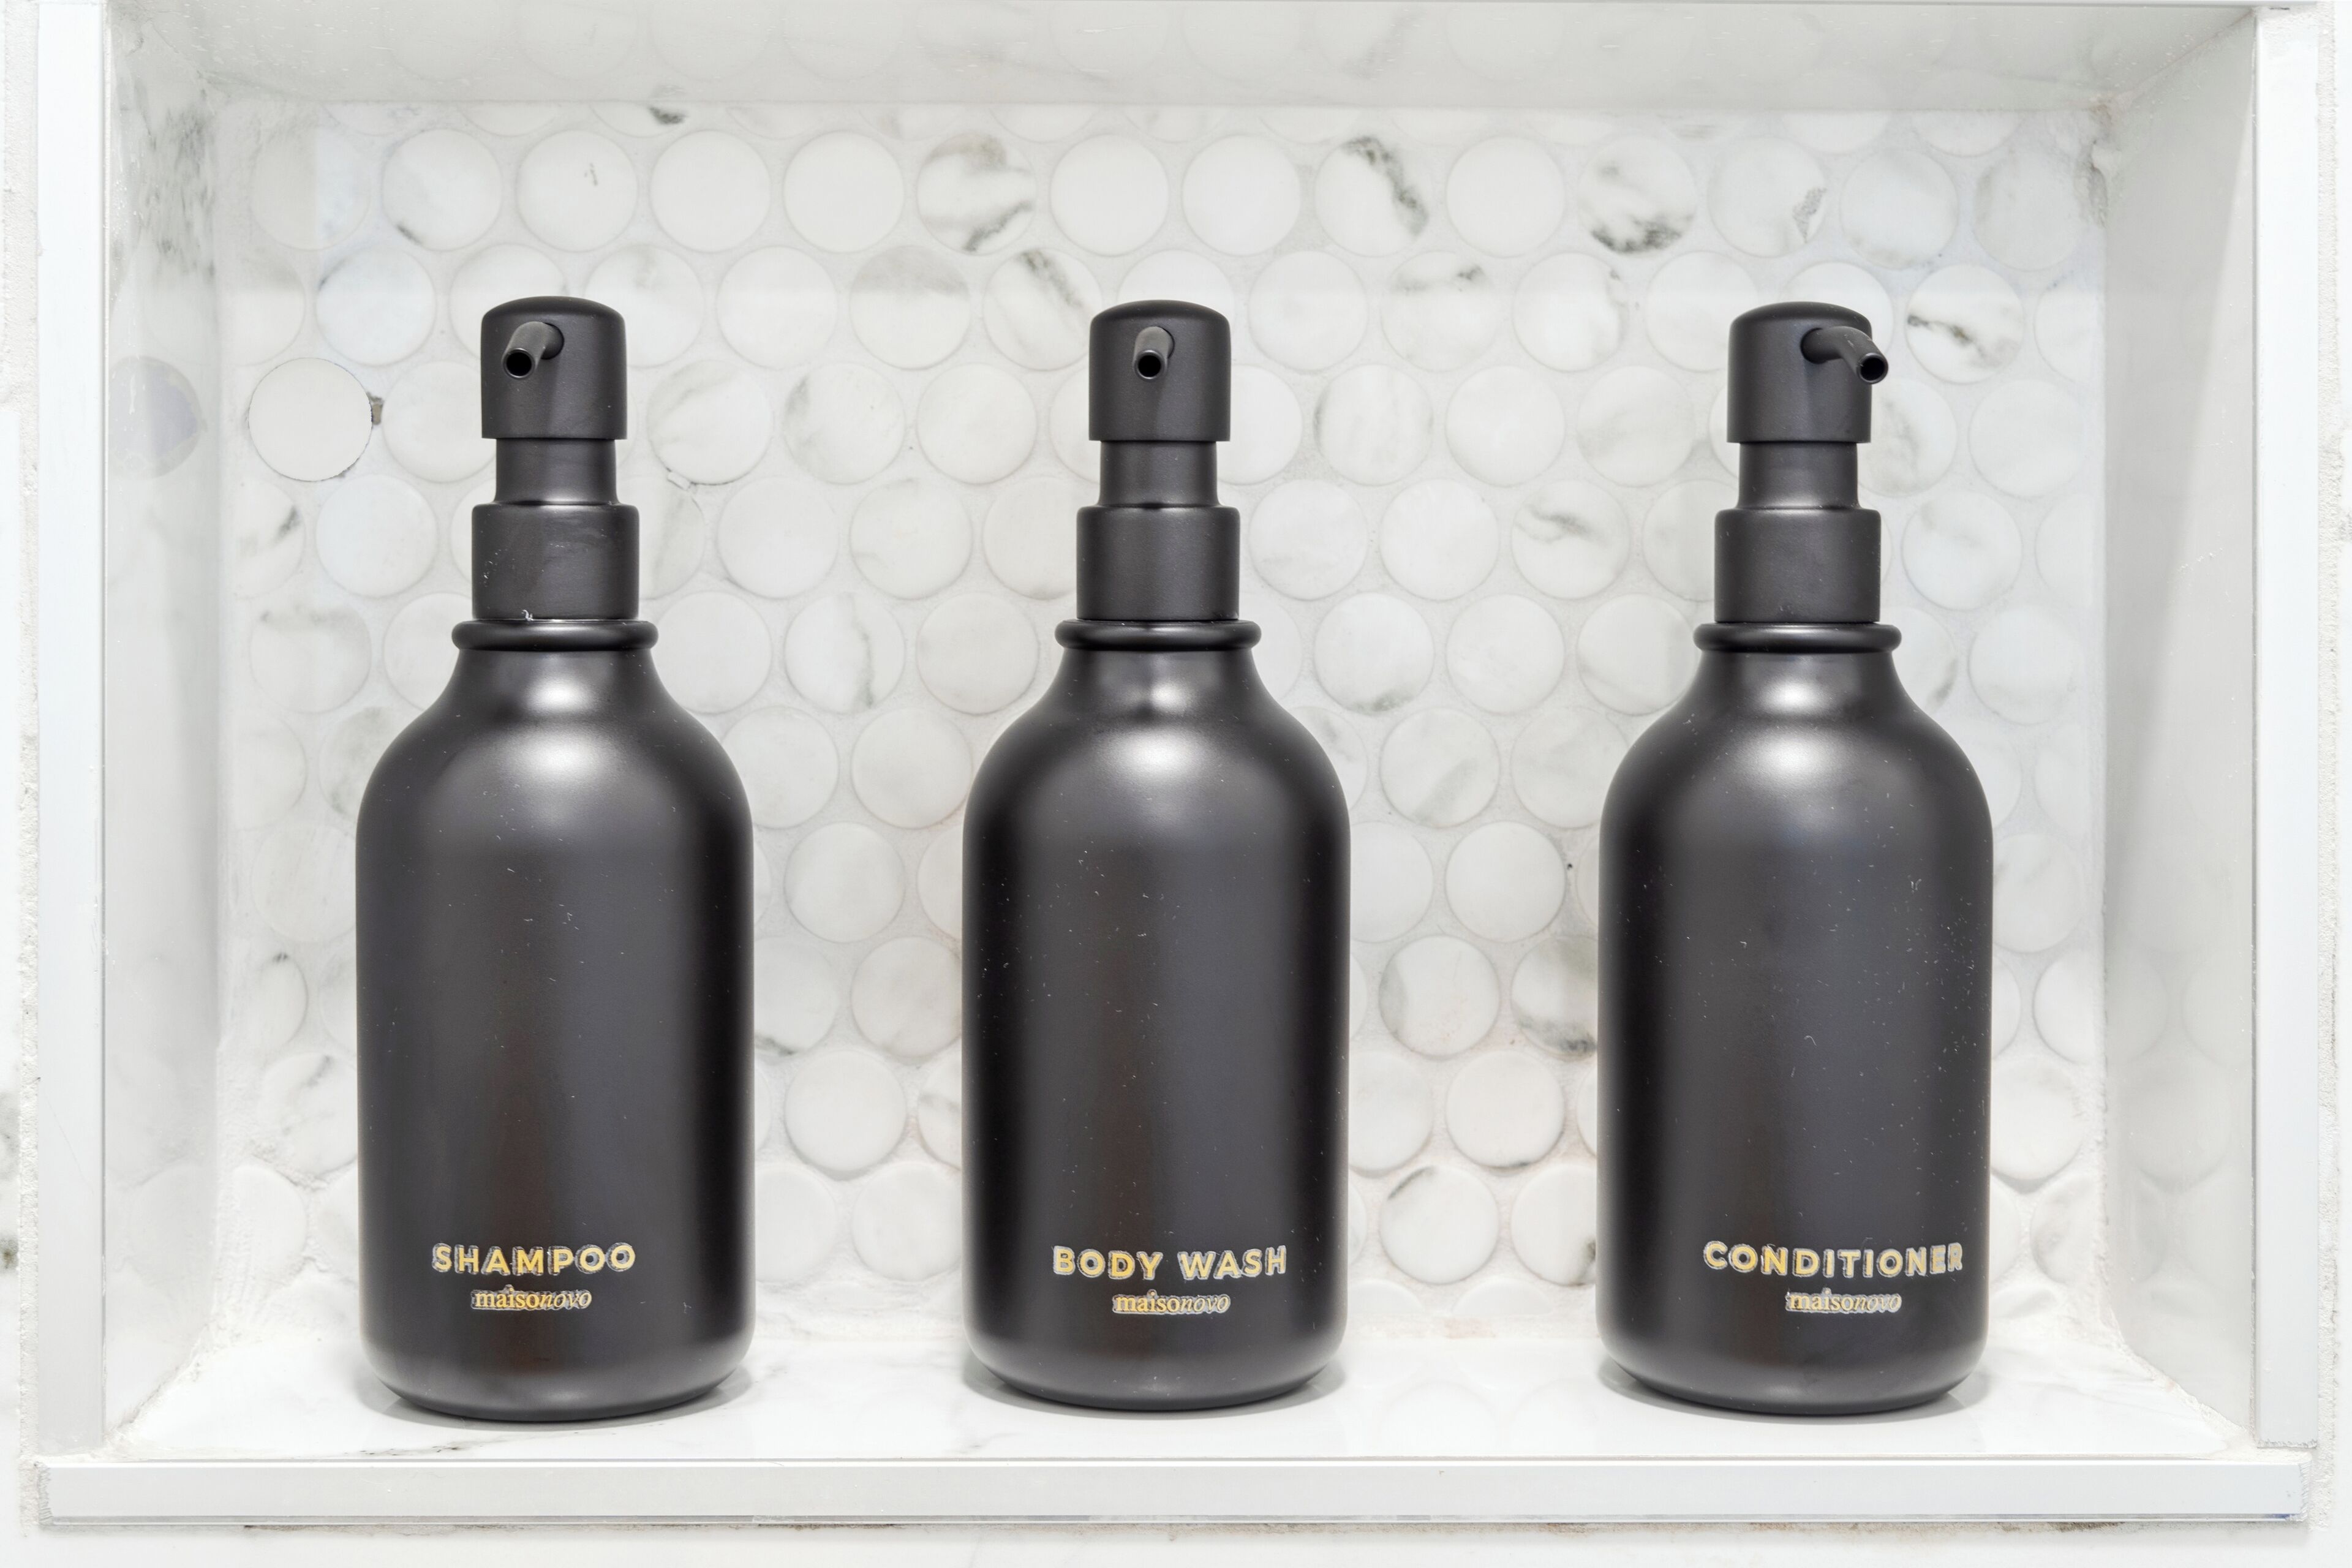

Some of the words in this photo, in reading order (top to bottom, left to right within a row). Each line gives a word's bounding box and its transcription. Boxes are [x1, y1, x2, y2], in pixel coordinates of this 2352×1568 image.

[433, 1243, 635, 1275] SHAMPOO
[1054, 1246, 1163, 1279] BODY
[1178, 1246, 1286, 1279] WASH
[1704, 1241, 1962, 1277] CONDITIONER
[473, 1286, 592, 1310] maisonovo
[1114, 1290, 1230, 1313] maisonovo
[1787, 1288, 1901, 1312] maisonovo
